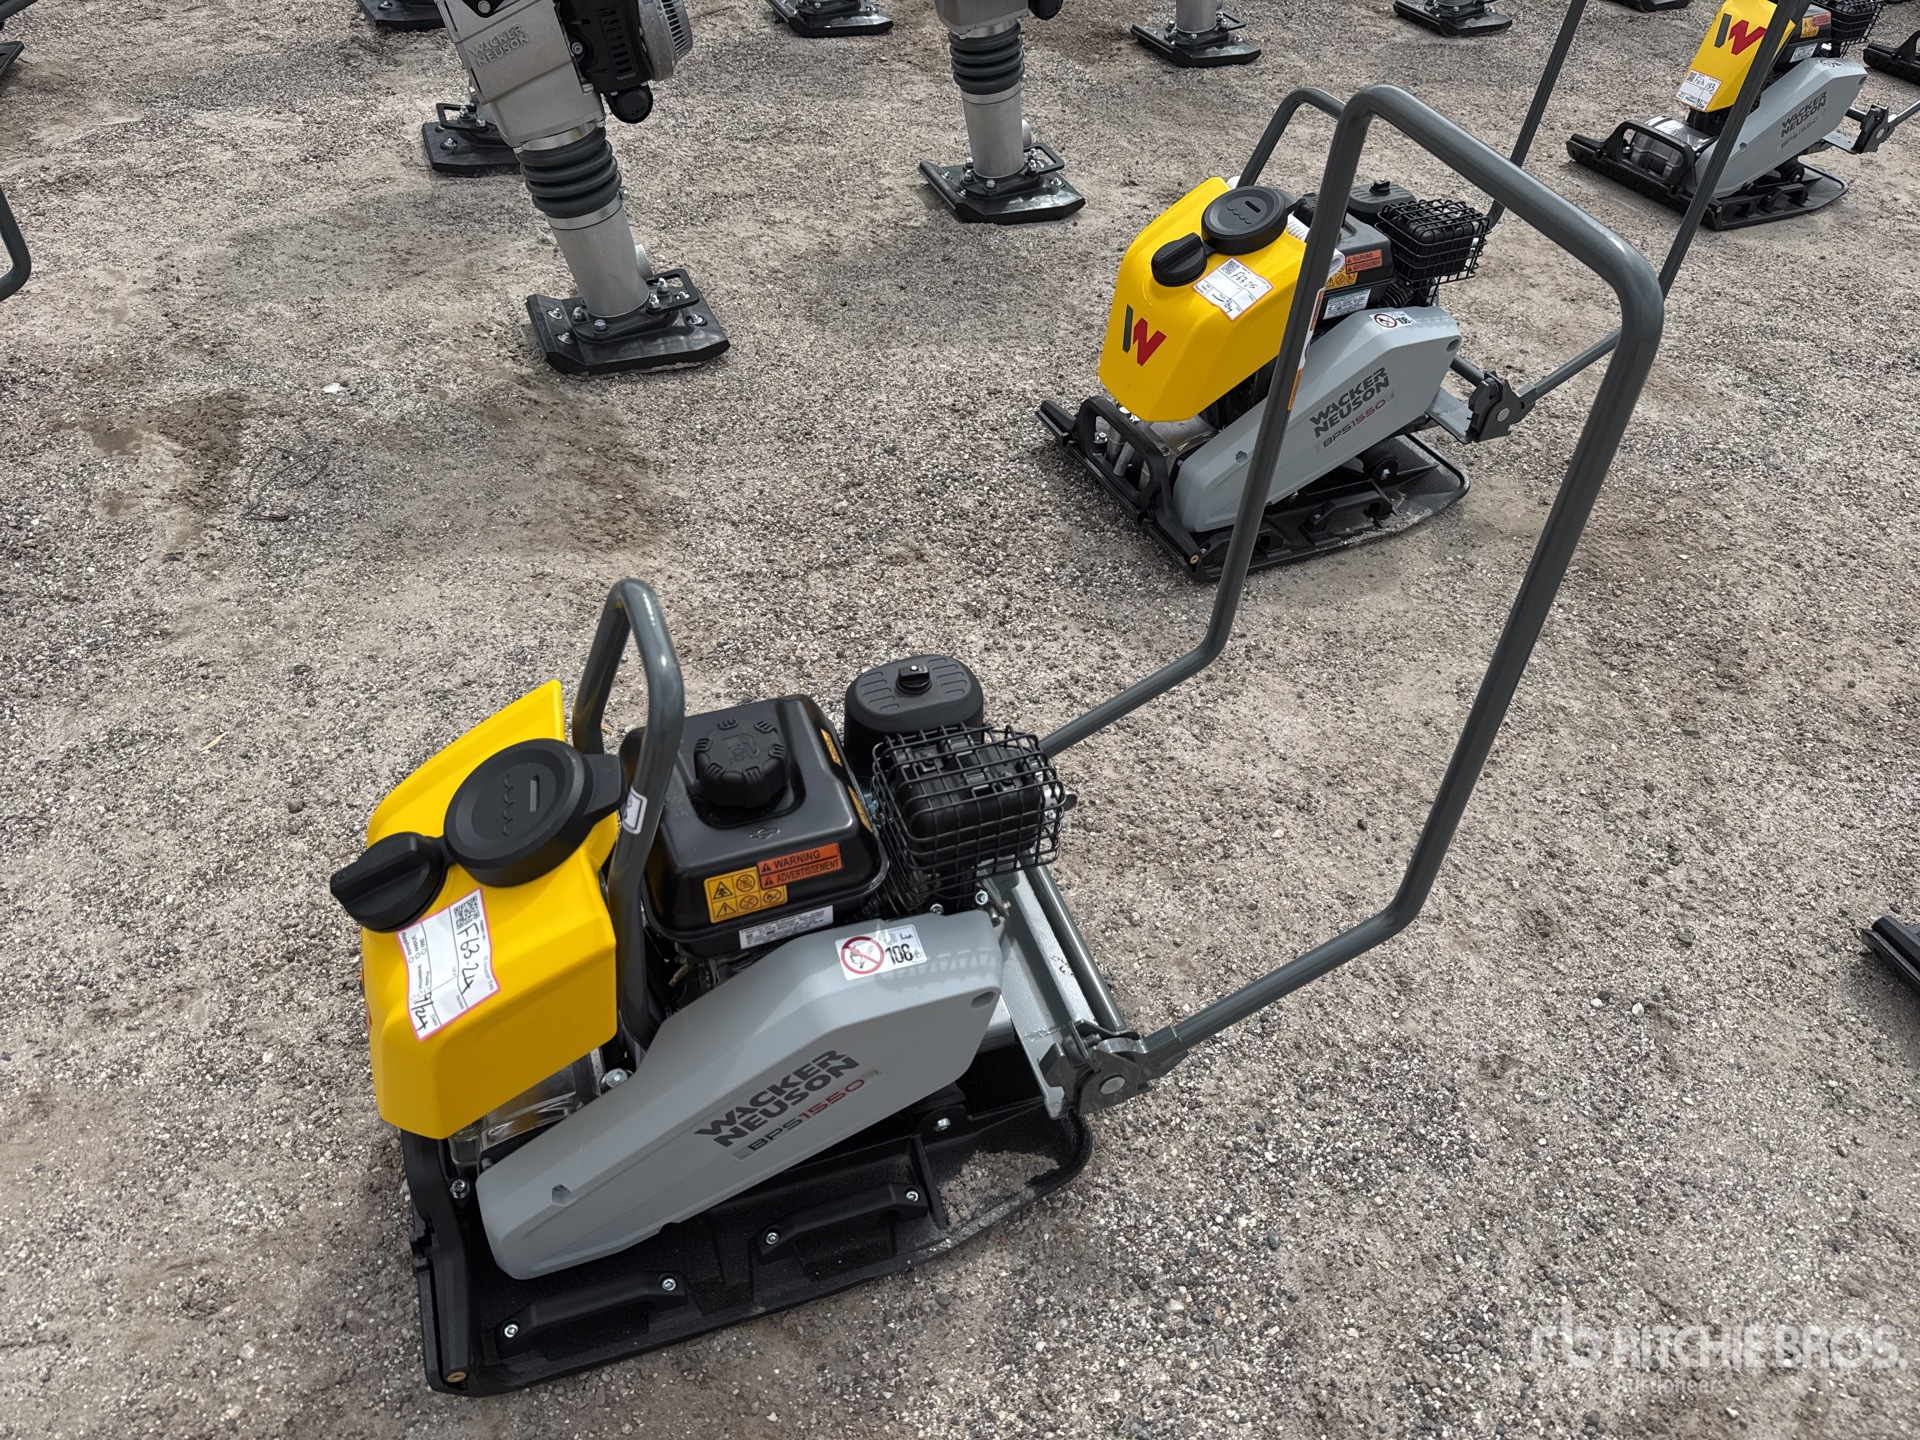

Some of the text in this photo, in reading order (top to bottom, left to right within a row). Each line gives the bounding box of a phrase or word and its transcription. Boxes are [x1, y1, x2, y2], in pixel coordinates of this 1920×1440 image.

[468, 23, 523, 57] WACKER
[475, 31, 530, 67] NEUSON
[1781, 98, 1826, 138] NEUSON
[1782, 91, 1827, 128] WACKER
[1309, 367, 1388, 425] WACKER
[1314, 376, 1390, 438] NEUSON
[1323, 399, 1386, 447] BPS1550
[773, 850, 820, 869] WARNING
[777, 859, 839, 883] ADVERTISSEMENT
[401, 931, 412, 956] Rephoto
[411, 935, 419, 952] Video
[693, 1050, 848, 1135] WACKER
[713, 1056, 860, 1147] NEUSON
[747, 1078, 865, 1151] BPS1550
